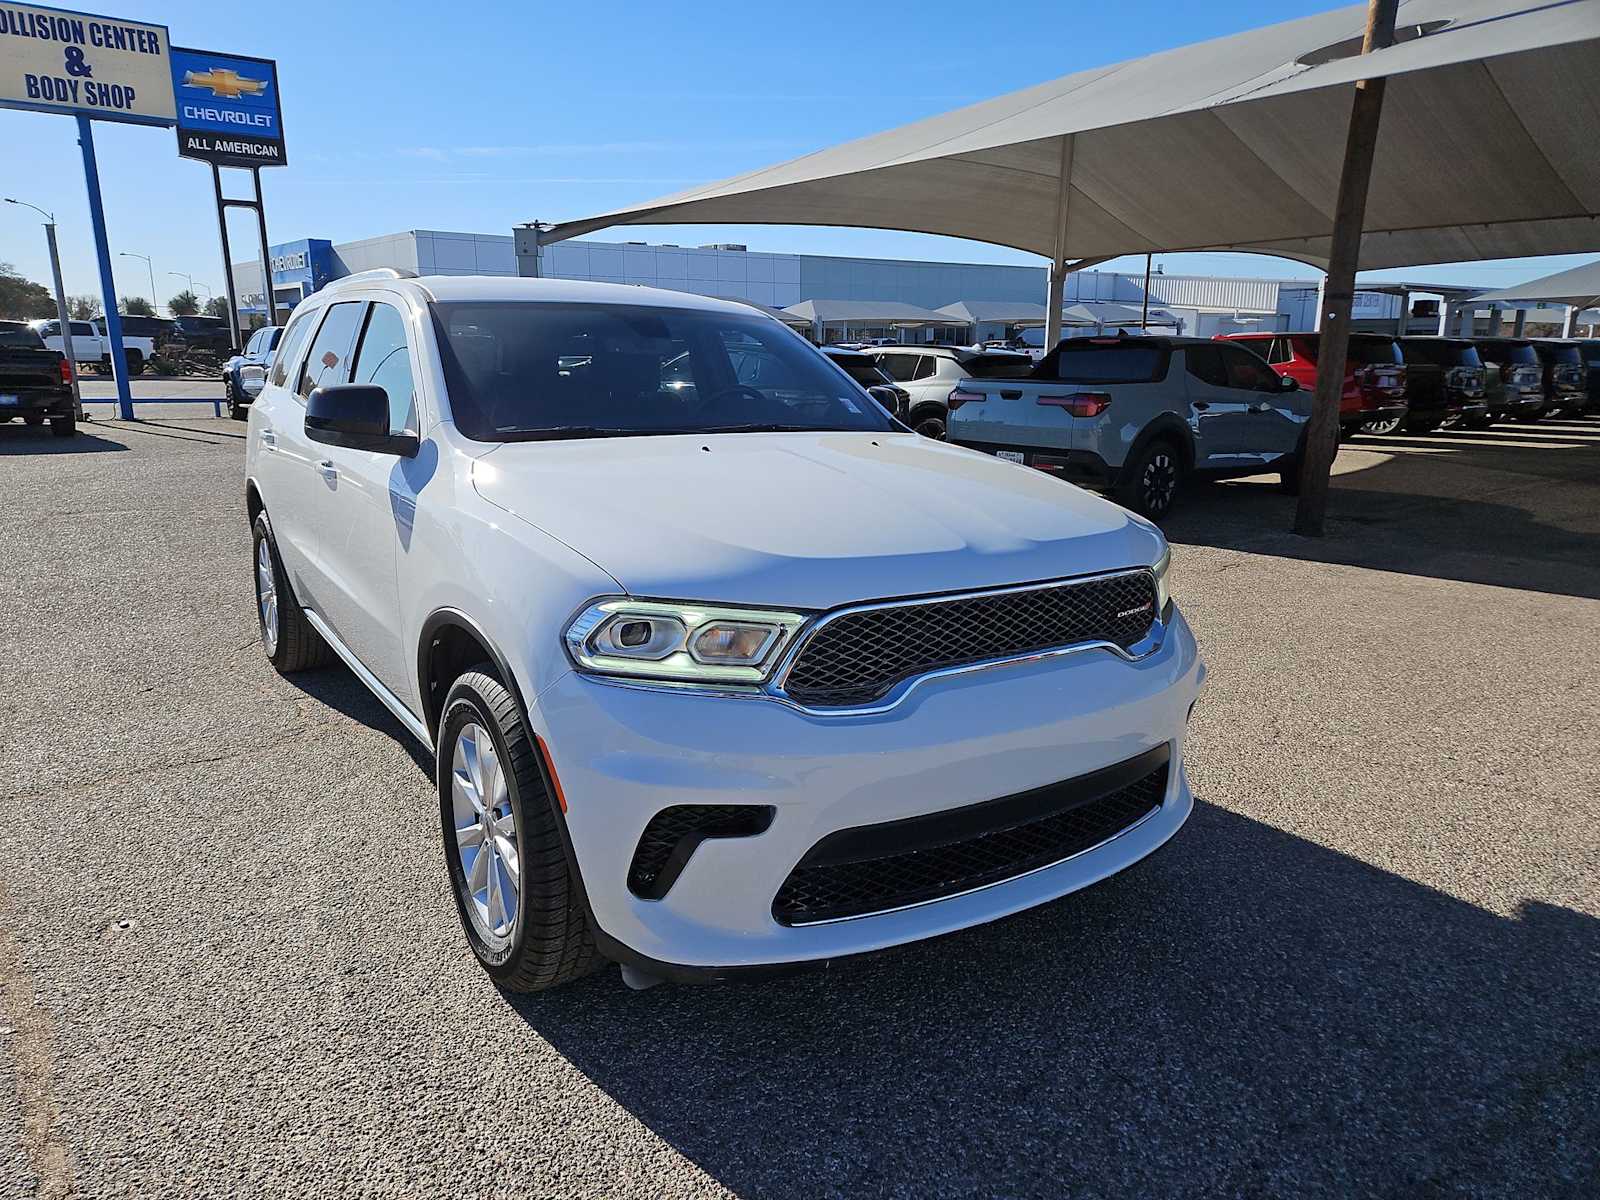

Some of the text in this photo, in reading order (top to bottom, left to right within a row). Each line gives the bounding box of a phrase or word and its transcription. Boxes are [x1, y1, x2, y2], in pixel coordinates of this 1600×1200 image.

[88, 22, 161, 55] CENTER
[64, 45, 93, 78] &
[24, 73, 136, 109] BODY SHOP
[183, 105, 273, 128] CHEVROLET
[187, 137, 279, 157] ALL AMERICAN
[1117, 604, 1148, 618] DODGE
